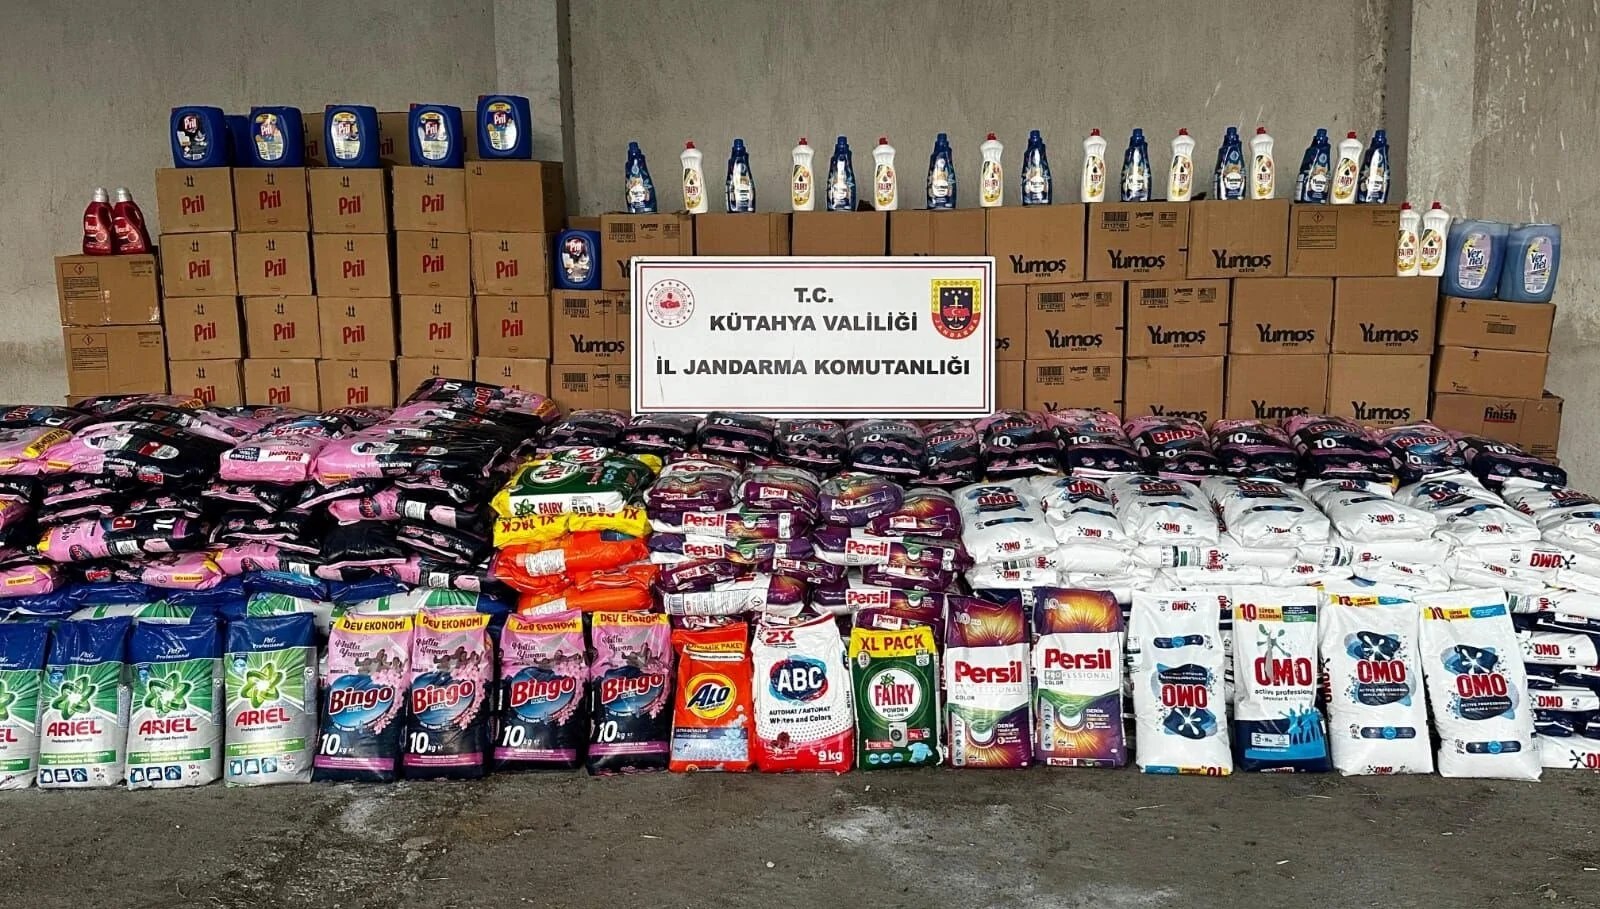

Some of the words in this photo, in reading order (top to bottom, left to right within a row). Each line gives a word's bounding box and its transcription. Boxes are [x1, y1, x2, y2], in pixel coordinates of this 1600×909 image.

[182, 196, 205, 215] Pril
[259, 192, 281, 210] Pril
[340, 197, 361, 215] Pril
[422, 195, 444, 212] Pril
[265, 259, 287, 278] Pril
[422, 254, 445, 273] Pril
[1009, 255, 1066, 274] Yumoş
[1107, 249, 1165, 270] Yumoş
[1212, 249, 1271, 270] Yumoş
[188, 260, 211, 279] Pril
[343, 260, 366, 279] Pril
[496, 260, 518, 279] Pril
[793, 287, 834, 303] T.C.
[501, 319, 524, 338] Pril
[709, 312, 817, 331] KÜTAHYA
[822, 312, 918, 331] VALİLİĞİ
[194, 323, 216, 342] Pril
[273, 322, 296, 341] Pril
[342, 324, 365, 344] Pril
[428, 322, 452, 341] Pril
[1045, 329, 1103, 348] Yumoş
[1146, 325, 1206, 346] Yumoş
[1256, 323, 1315, 344] Yumoş
[1359, 323, 1419, 343] Yumoş
[570, 334, 625, 354] Yumoş
[656, 356, 677, 375] İL
[683, 359, 807, 375] JANDARMA
[814, 356, 970, 375] KOMUTANLIĞI
[193, 385, 216, 404] Pril
[268, 385, 291, 405] Pril
[346, 386, 369, 405] Pril
[1352, 401, 1411, 421] Yumoş
[1484, 406, 1517, 420] finish
[713, 417, 733, 427] 10
[993, 436, 1011, 447] 10
[1070, 436, 1090, 444] 10
[1228, 431, 1247, 444] 10
[1314, 437, 1337, 449] 10
[1484, 444, 1505, 454] 10
[538, 502, 564, 514] FAIRY
[977, 494, 1018, 505] OMO
[684, 513, 727, 527] Persil
[1085, 529, 1101, 538] OMO
[684, 543, 724, 557] Persil
[846, 539, 889, 557] Persil
[1004, 541, 1020, 551] OMO
[1004, 570, 1020, 579] OMO
[846, 591, 889, 606] Persil
[343, 620, 366, 631] DEV
[365, 619, 405, 631] EKONOMİ
[422, 616, 442, 628] DEV
[441, 616, 483, 630] EKONOMİ
[600, 613, 619, 623] DEV
[621, 613, 661, 623] EKONOMİ
[876, 615, 899, 624] Persil
[765, 630, 795, 644] 2X
[861, 637, 881, 651] XL
[884, 634, 925, 651] PACK
[1044, 648, 1112, 669] Persil
[1535, 644, 1560, 656] OMO
[777, 666, 823, 692] ABC
[955, 661, 1023, 683] Persil
[1255, 657, 1313, 687] OMO
[1356, 660, 1406, 684] OMO
[511, 677, 576, 707] Bingo
[602, 673, 664, 705] Bingo
[1456, 673, 1507, 698] OMO
[329, 686, 394, 715] Bingo
[412, 681, 475, 714] Bingo
[874, 684, 914, 707] FAIRY
[1161, 684, 1208, 708] OMO
[1538, 696, 1563, 708] OMO
[138, 718, 198, 736] ARIEL
[236, 708, 291, 727] ARIEL
[809, 714, 832, 722] Colors
[47, 721, 102, 737] ARIEL
[502, 725, 525, 747] 10
[597, 721, 618, 743] 10
[320, 733, 341, 755] 10
[339, 746, 348, 754] kg
[409, 732, 428, 754] 10
[428, 743, 437, 753] kg
[818, 751, 827, 762] 9
[828, 750, 843, 763] kg
[1050, 757, 1075, 766] Persil
